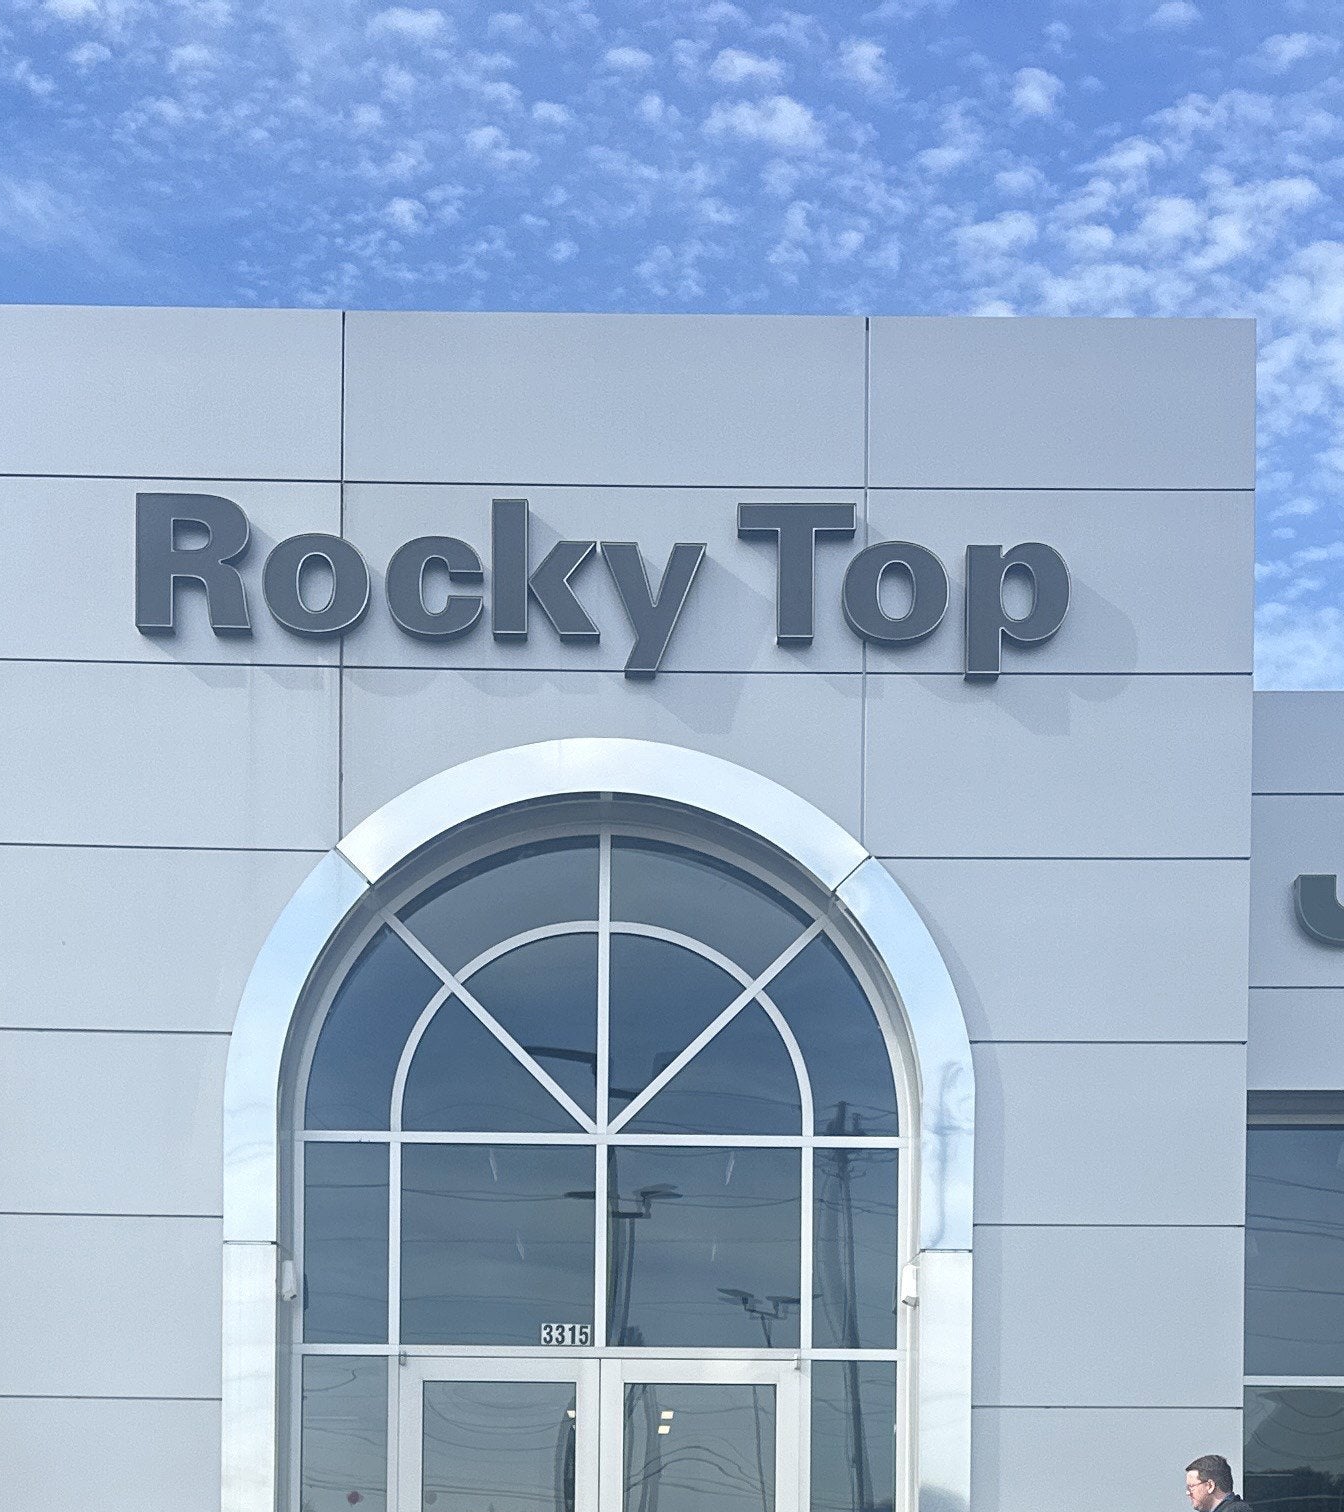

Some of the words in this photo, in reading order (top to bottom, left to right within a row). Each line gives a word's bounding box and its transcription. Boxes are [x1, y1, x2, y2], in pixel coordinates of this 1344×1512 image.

[134, 492, 707, 679] Rocky
[736, 502, 1072, 681] Top
[543, 1324, 589, 1345] 3315
